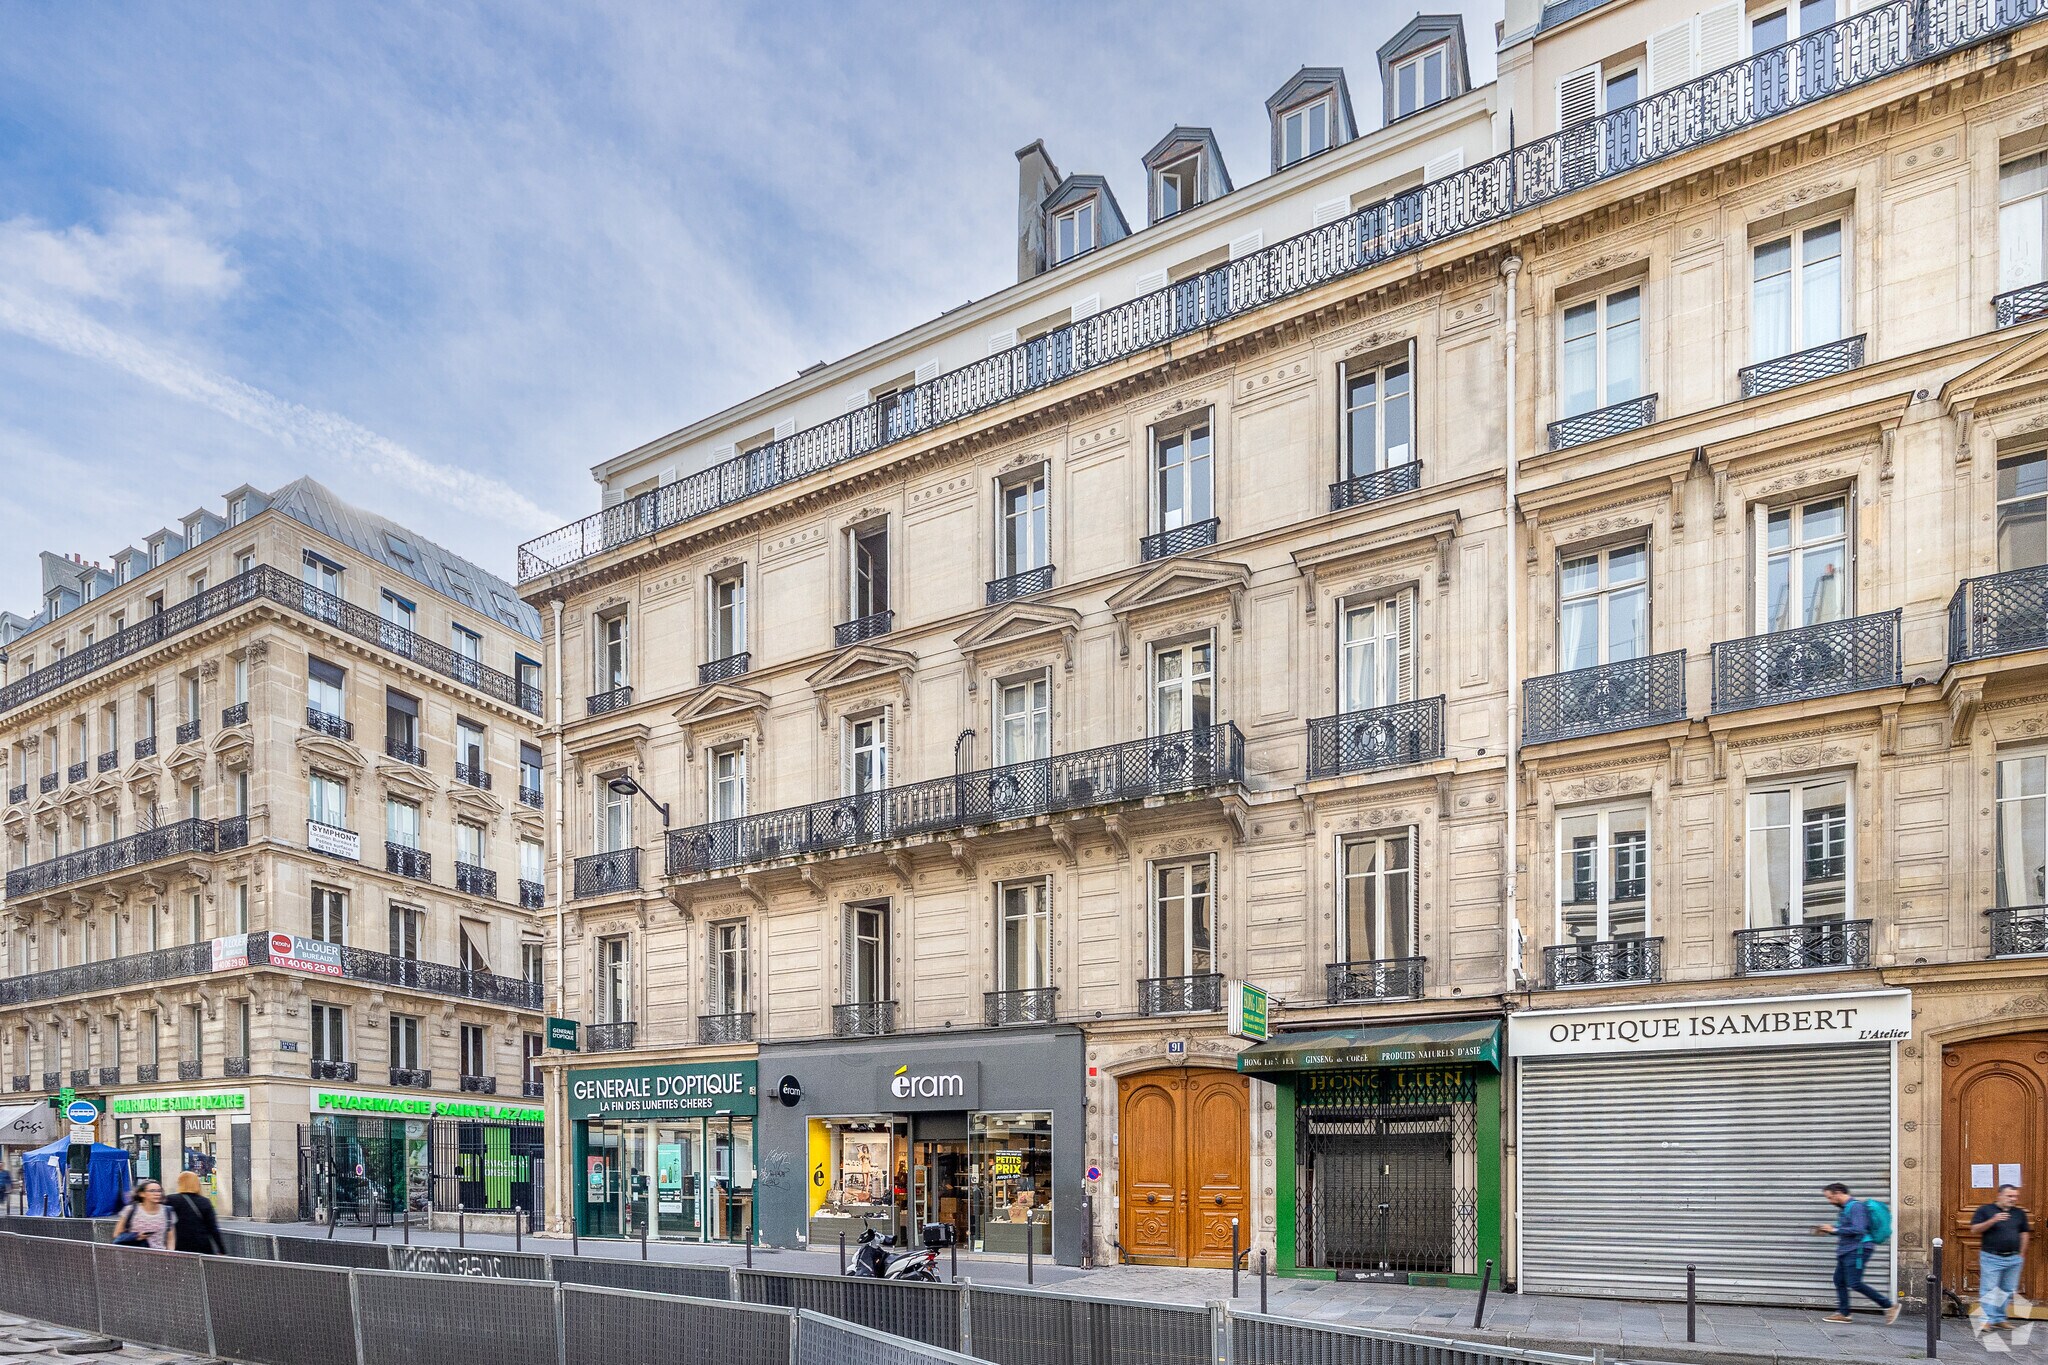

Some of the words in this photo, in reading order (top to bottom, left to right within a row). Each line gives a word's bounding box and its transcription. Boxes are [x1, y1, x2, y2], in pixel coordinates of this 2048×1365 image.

[312, 825, 357, 842] SYMPHONY
[332, 837, 352, 847] Bureaux
[333, 843, 353, 852] surfaces
[296, 938, 304, 950] À
[305, 941, 339, 956] LOUER
[302, 952, 334, 963] BUREAUX
[273, 957, 285, 965] 01
[287, 959, 300, 968] 40
[301, 962, 313, 971] 06
[314, 963, 326, 972] 29
[327, 966, 339, 975] 60
[552, 1027, 574, 1036] GENERALE
[1550, 1018, 1681, 1043] OPTIQUE
[1689, 1008, 1858, 1036] ISAMBERT
[552, 1033, 574, 1041] D'OPTIQUE
[1858, 1028, 1910, 1040] L'Atelier
[1171, 1042, 1180, 1052] 91
[1244, 1058, 1262, 1067] HONG
[1305, 1054, 1334, 1064] GINSENG
[1381, 1051, 1416, 1060] PRODUITS
[1418, 1048, 1455, 1059] NATURELS
[1457, 1046, 1481, 1056] D'ASIE
[573, 1077, 651, 1100] GENERALE
[656, 1073, 743, 1097] D'OPTIQUE
[891, 1064, 964, 1098] éram
[1310, 1073, 1380, 1090] HONG
[1397, 1070, 1464, 1087] LIEN
[782, 1083, 801, 1096] éram
[114, 1097, 169, 1113] PHARMACIE
[318, 1093, 431, 1114] PHARMACIE
[600, 1101, 610, 1112] LA
[611, 1100, 625, 1111] FIN
[625, 1099, 641, 1110] DES
[642, 1098, 679, 1110] LUNETTES
[680, 1097, 713, 1109] CHERES
[13, 1119, 45, 1134] Gigi
[187, 1119, 216, 1130] NATURE
[995, 1155, 1022, 1164] PETITS
[813, 1162, 825, 1187] é
[995, 1164, 1021, 1175] PRIX
